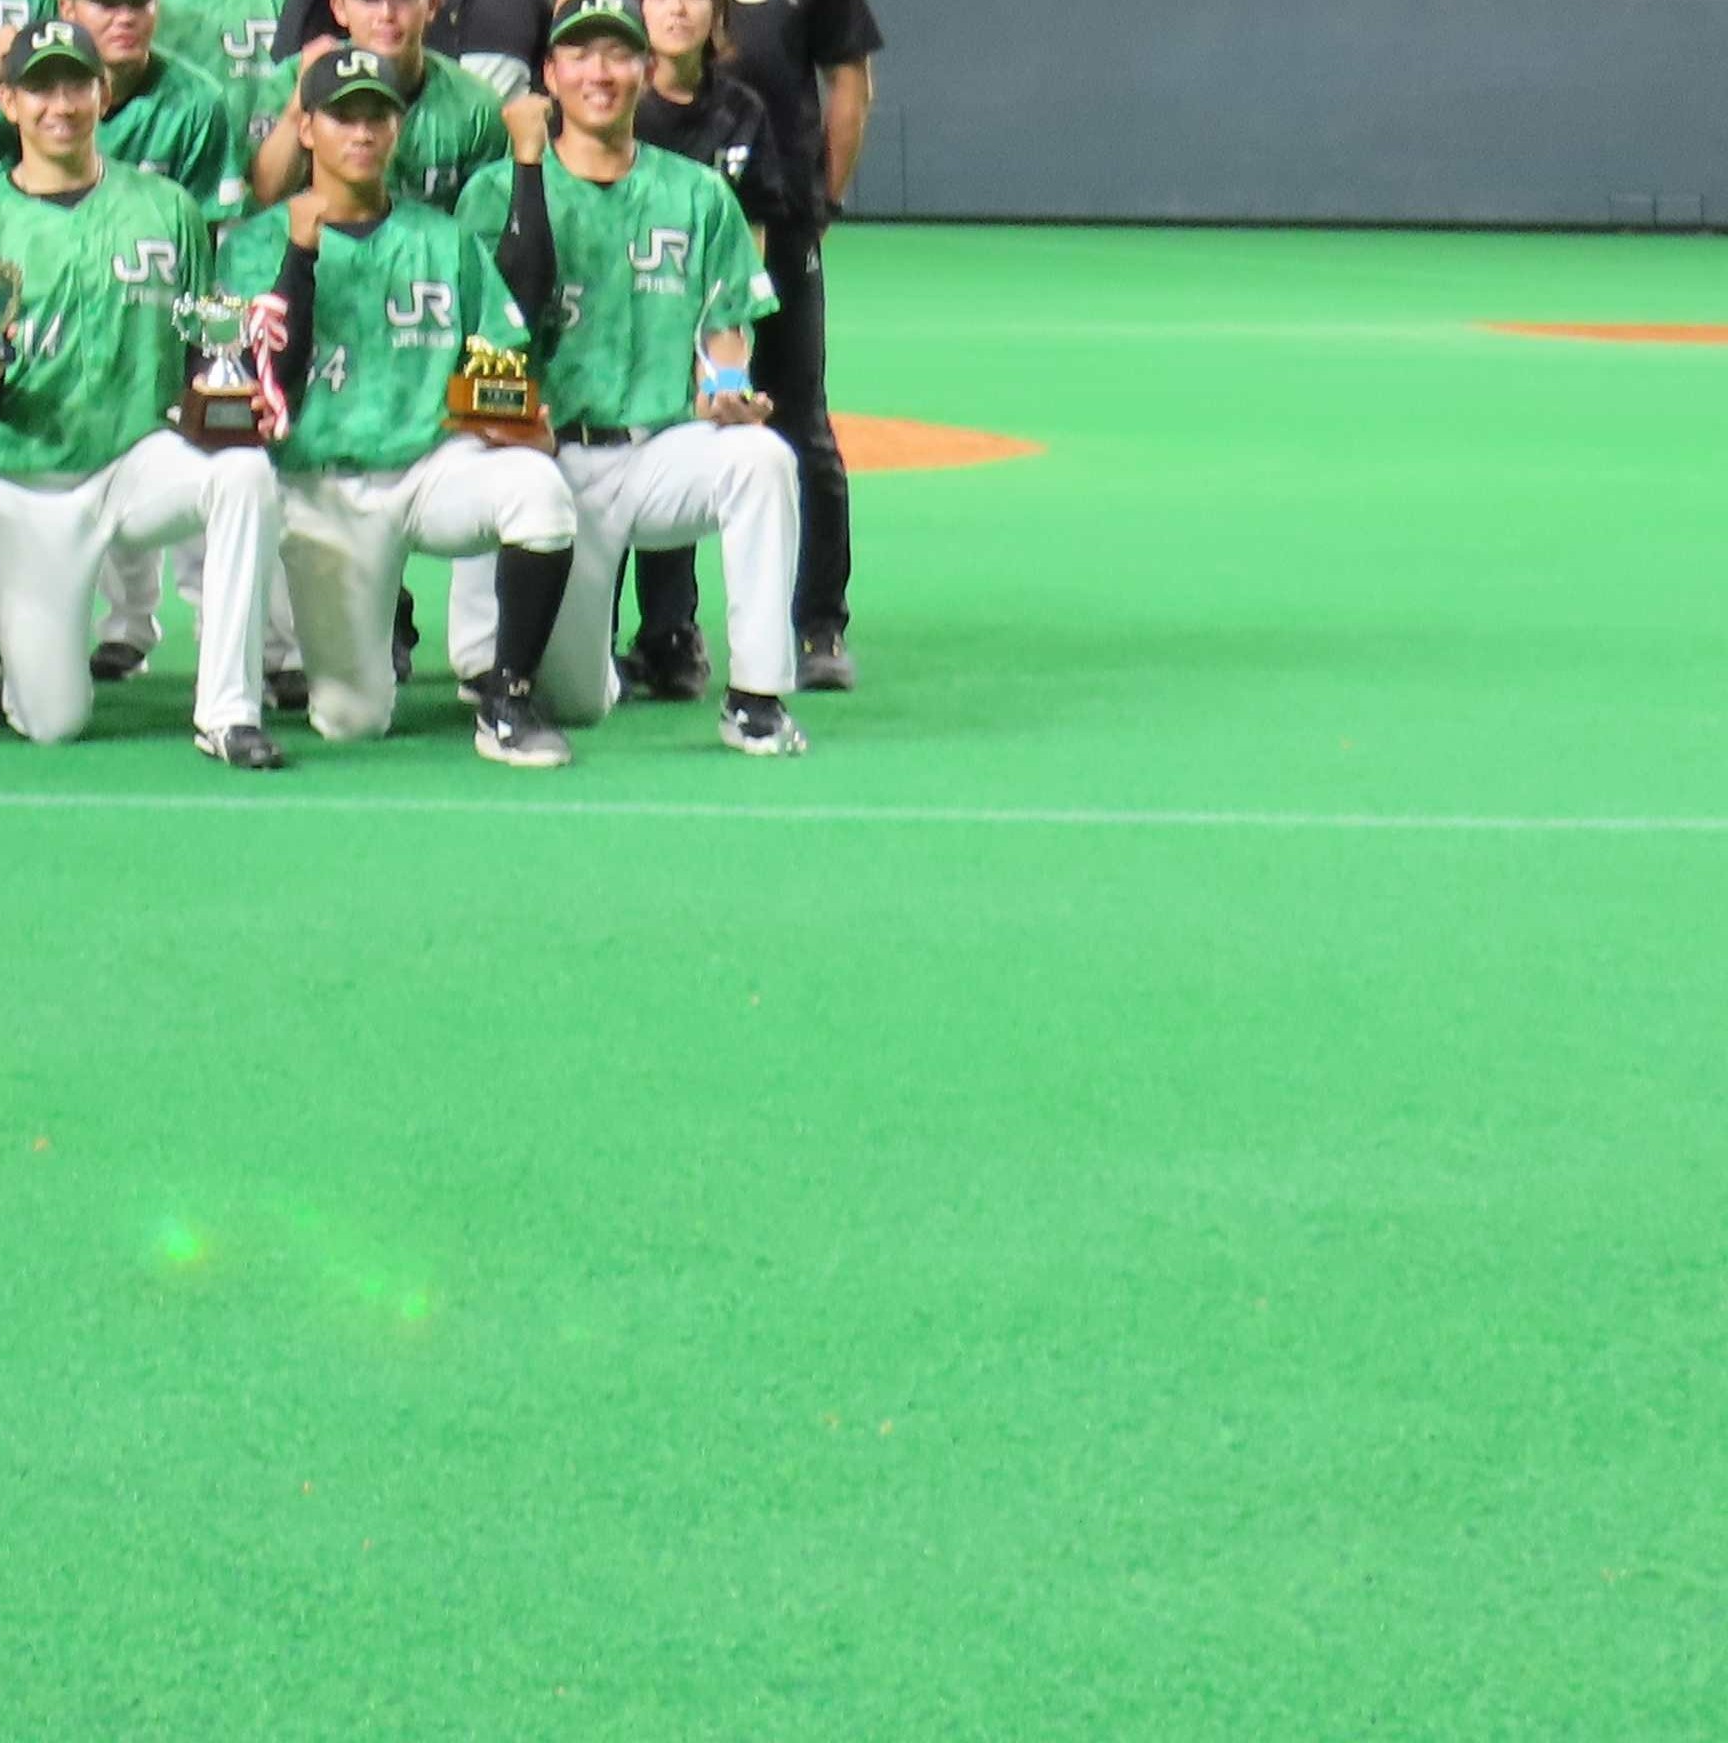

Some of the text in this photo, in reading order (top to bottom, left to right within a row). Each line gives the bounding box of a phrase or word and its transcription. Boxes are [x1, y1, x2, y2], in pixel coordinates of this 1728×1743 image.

[32, 21, 74, 50] JR
[336, 52, 378, 77] JR
[112, 238, 177, 285] JR
[627, 226, 690, 276] JR
[386, 281, 452, 329] JR
